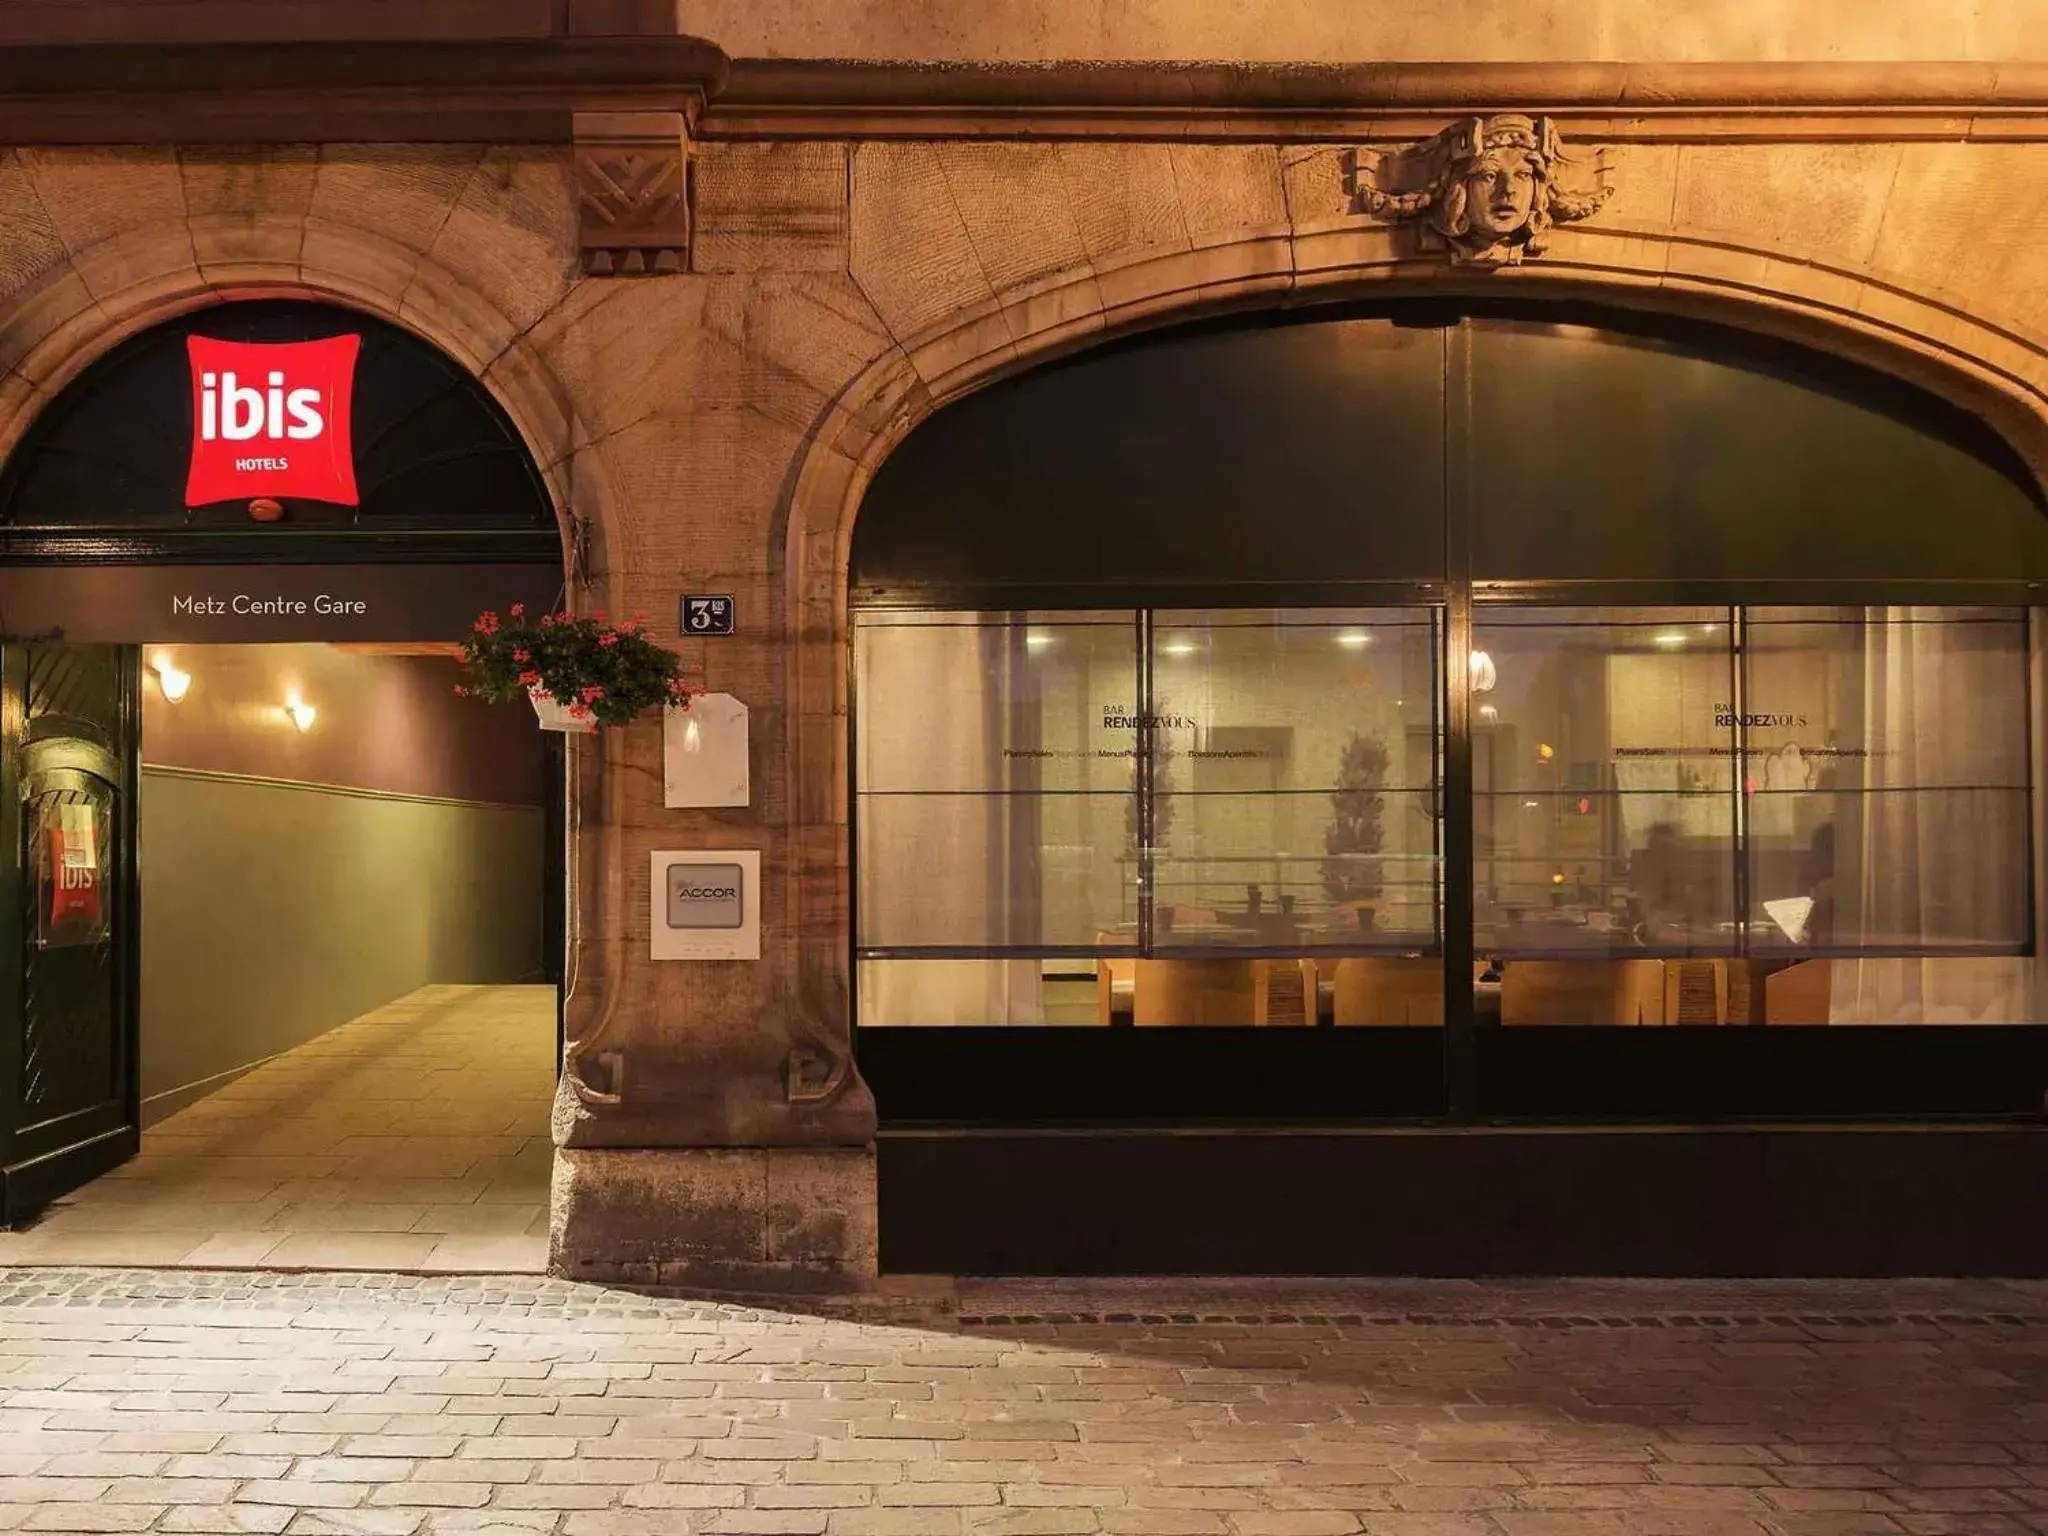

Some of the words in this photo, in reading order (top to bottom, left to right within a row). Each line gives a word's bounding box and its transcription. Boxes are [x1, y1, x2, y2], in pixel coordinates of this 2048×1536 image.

[202, 371, 324, 440] ibis
[235, 457, 288, 471] HOTELS
[173, 595, 225, 614] Metz
[232, 595, 306, 614] Centre
[314, 594, 366, 614] Gare
[691, 600, 710, 629] 3
[1103, 705, 1125, 715] BAR
[680, 888, 736, 898] ACCOR
